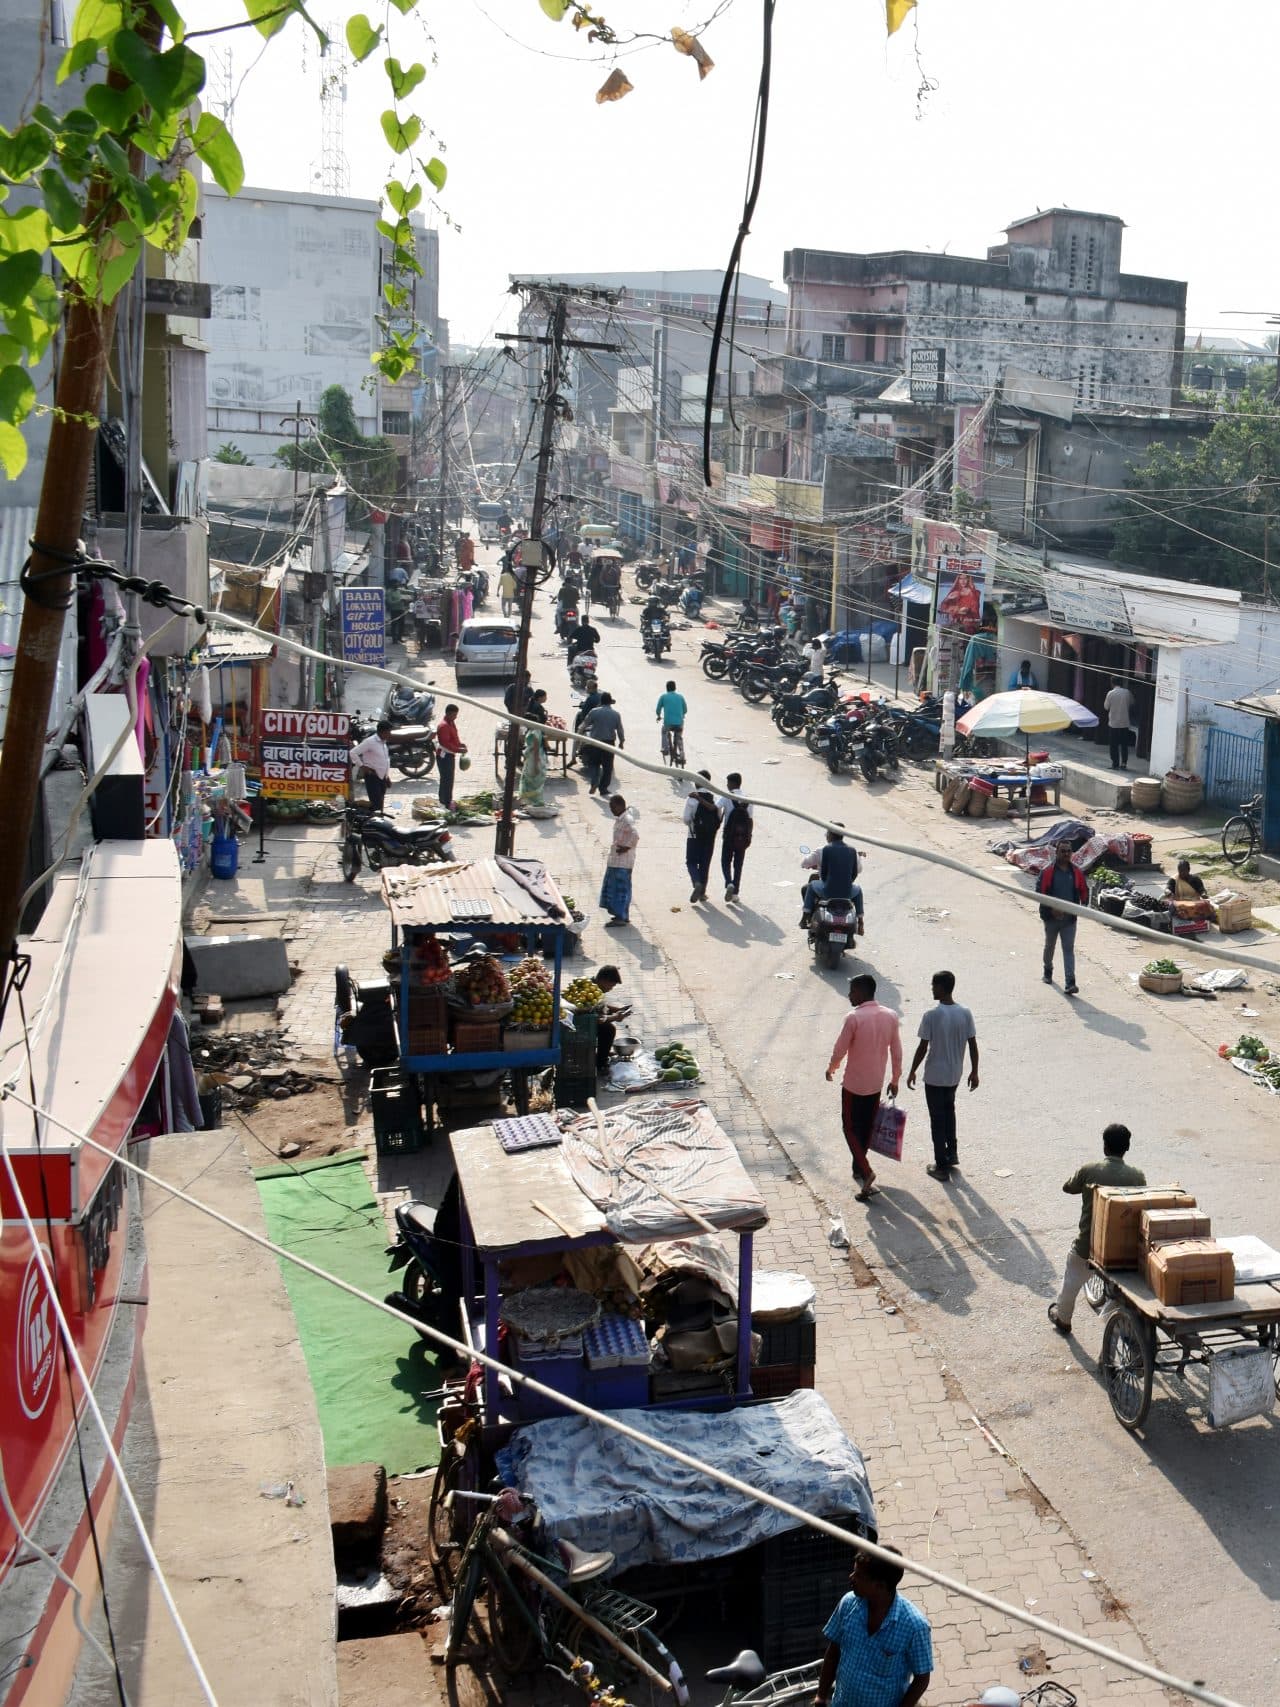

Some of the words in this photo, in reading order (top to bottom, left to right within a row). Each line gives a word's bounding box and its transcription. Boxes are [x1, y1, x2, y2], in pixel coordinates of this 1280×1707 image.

[345, 592, 381, 601] BABA
[346, 612, 374, 621] GIFT
[351, 622, 381, 631] HOUSE
[345, 633, 362, 649] CITY
[363, 633, 383, 649] GOLD
[263, 761, 302, 780] सिटी
[302, 763, 347, 782] गोल्ड
[270, 783, 341, 793] COSMETICS
